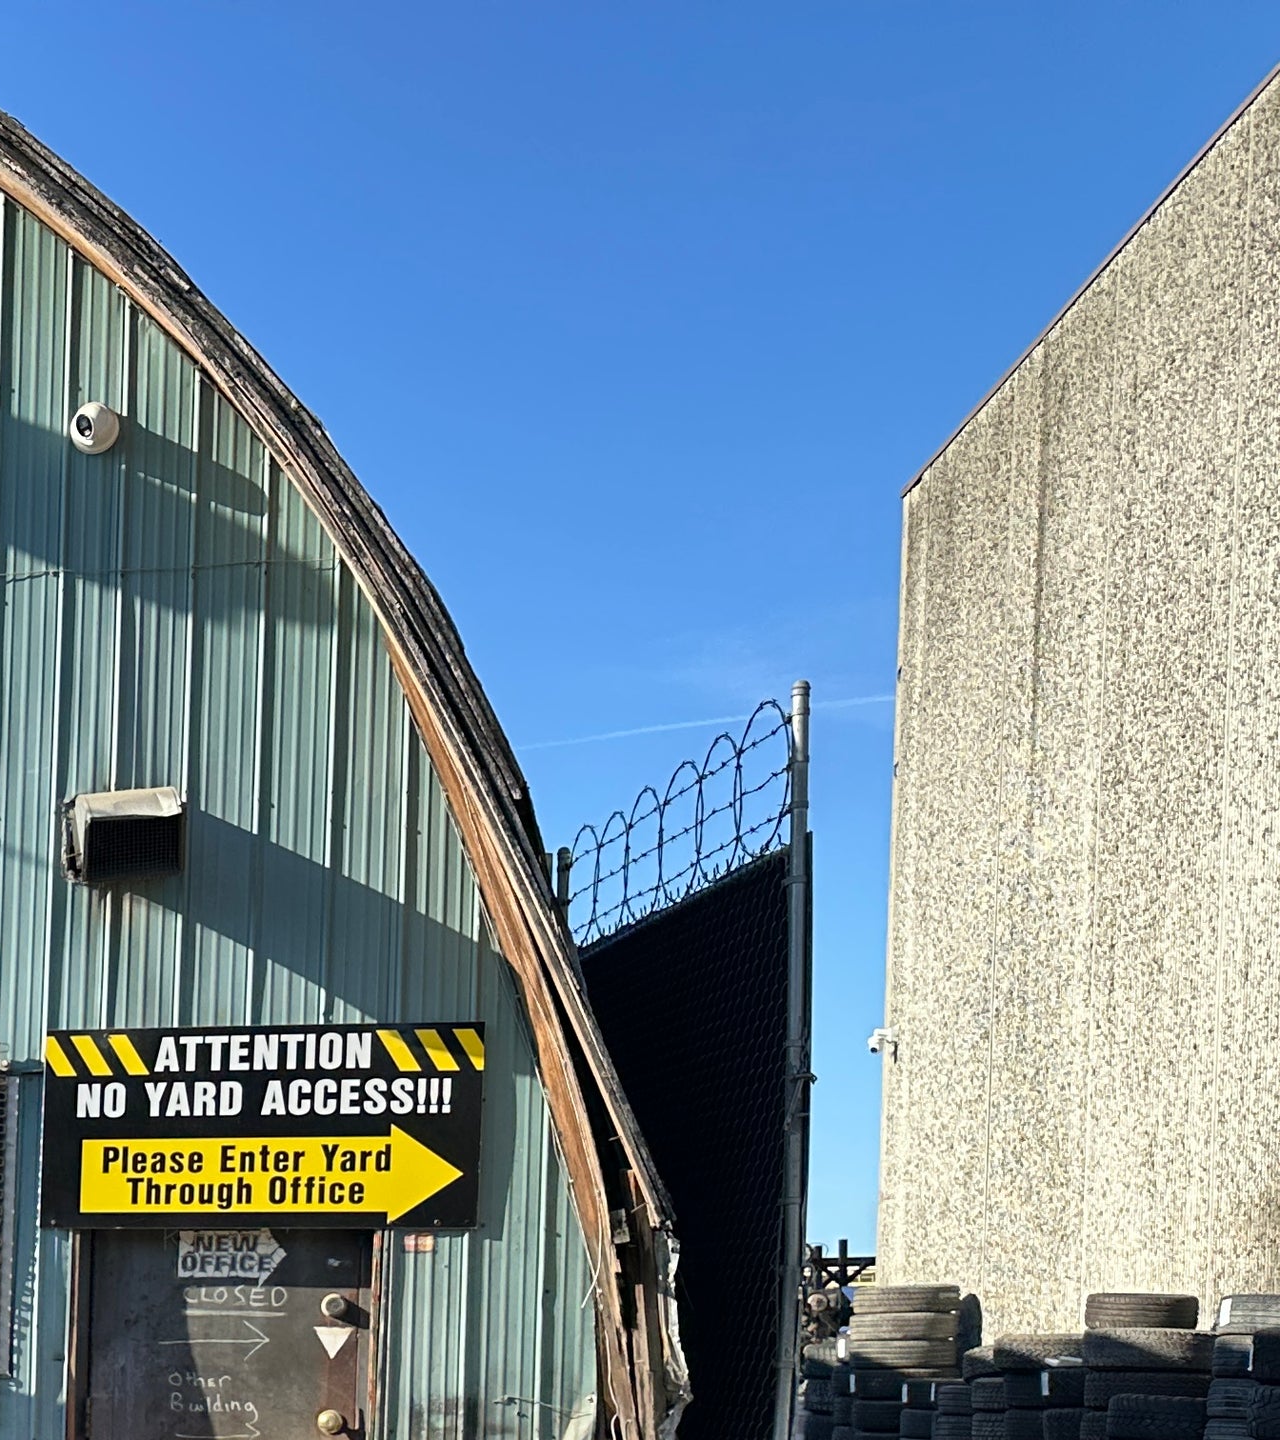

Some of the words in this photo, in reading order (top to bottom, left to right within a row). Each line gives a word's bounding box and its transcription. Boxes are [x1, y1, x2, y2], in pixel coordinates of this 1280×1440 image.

[153, 1032, 373, 1074] ATTENTION
[76, 1082, 127, 1118] NO
[144, 1080, 244, 1117] YARD
[260, 1077, 453, 1117] ACCESS!!!
[102, 1146, 204, 1174] Please
[219, 1144, 306, 1173] Enter
[320, 1143, 393, 1172] Yard
[126, 1177, 253, 1209] Through
[268, 1175, 365, 1204] Office
[194, 1232, 258, 1252] NEW
[181, 1251, 273, 1273] OFFICE
[183, 1284, 288, 1307] CLOSED
